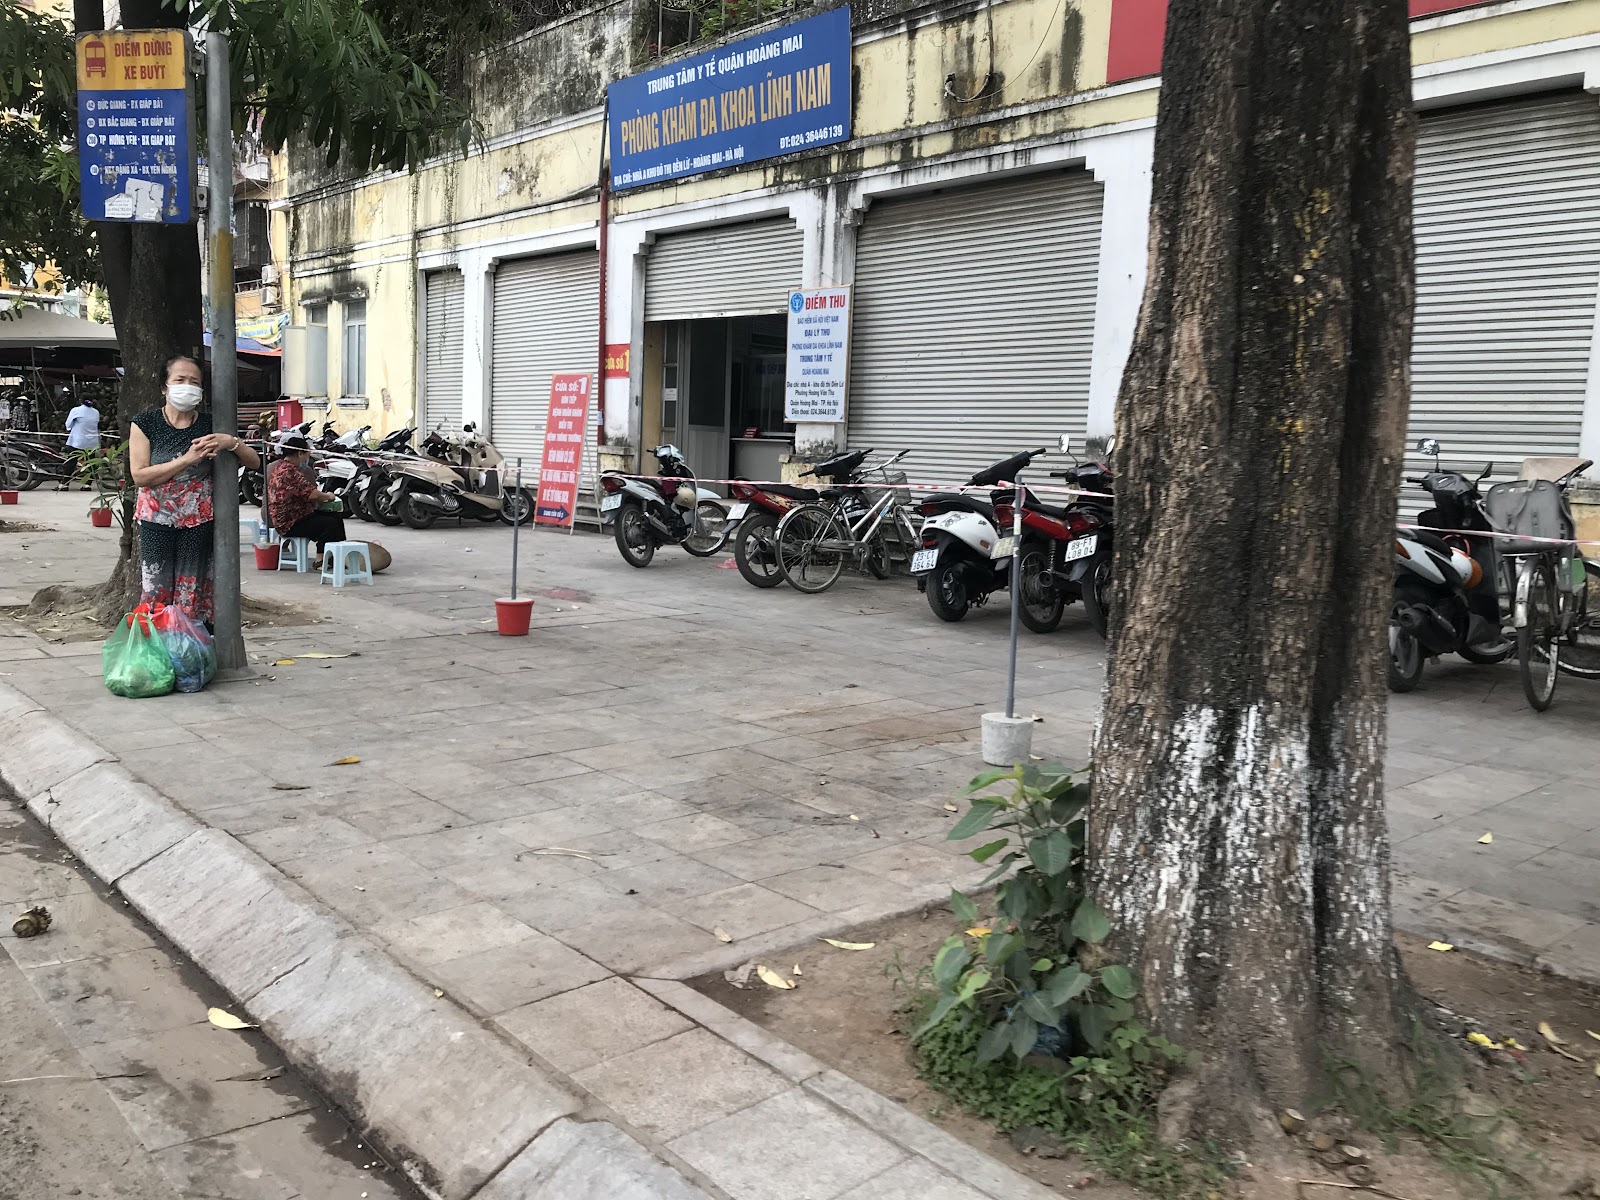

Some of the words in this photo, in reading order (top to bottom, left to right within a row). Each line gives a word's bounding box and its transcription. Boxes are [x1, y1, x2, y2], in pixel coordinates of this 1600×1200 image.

[114, 37, 141, 57] ĐIỂM
[144, 38, 172, 57] DỪNG
[124, 65, 137, 80] XE
[140, 62, 166, 80] BUÝT
[647, 75, 675, 95] TRUNG
[676, 67, 696, 86] TÂM
[698, 65, 703, 80] Y
[705, 54, 716, 78] TẾ
[718, 52, 744, 74] QUẬN
[746, 42, 781, 65] HOÀNG
[782, 33, 803, 55] MAI
[621, 109, 659, 157] PHÒNG
[661, 96, 698, 146] KHÁM
[699, 96, 718, 137] ĐA
[720, 85, 757, 132] KHOA
[760, 71, 793, 122] LĨNH
[796, 62, 831, 113] NAM
[98, 117, 106, 127] BX
[120, 117, 137, 127] GIANG
[141, 117, 149, 127] BX
[141, 134, 149, 146] BX
[646, 167, 656, 178] KHU
[692, 153, 711, 169] HOÀNG
[711, 151, 722, 165] MAI
[725, 146, 733, 162] HÀ
[733, 144, 744, 161] NỘI
[805, 291, 827, 310] ĐIỂM
[829, 294, 846, 309] THU
[820, 328, 830, 336] THU
[624, 349, 630, 372] 1
[578, 376, 587, 394] 1
[1070, 537, 1092, 551] 89-F1
